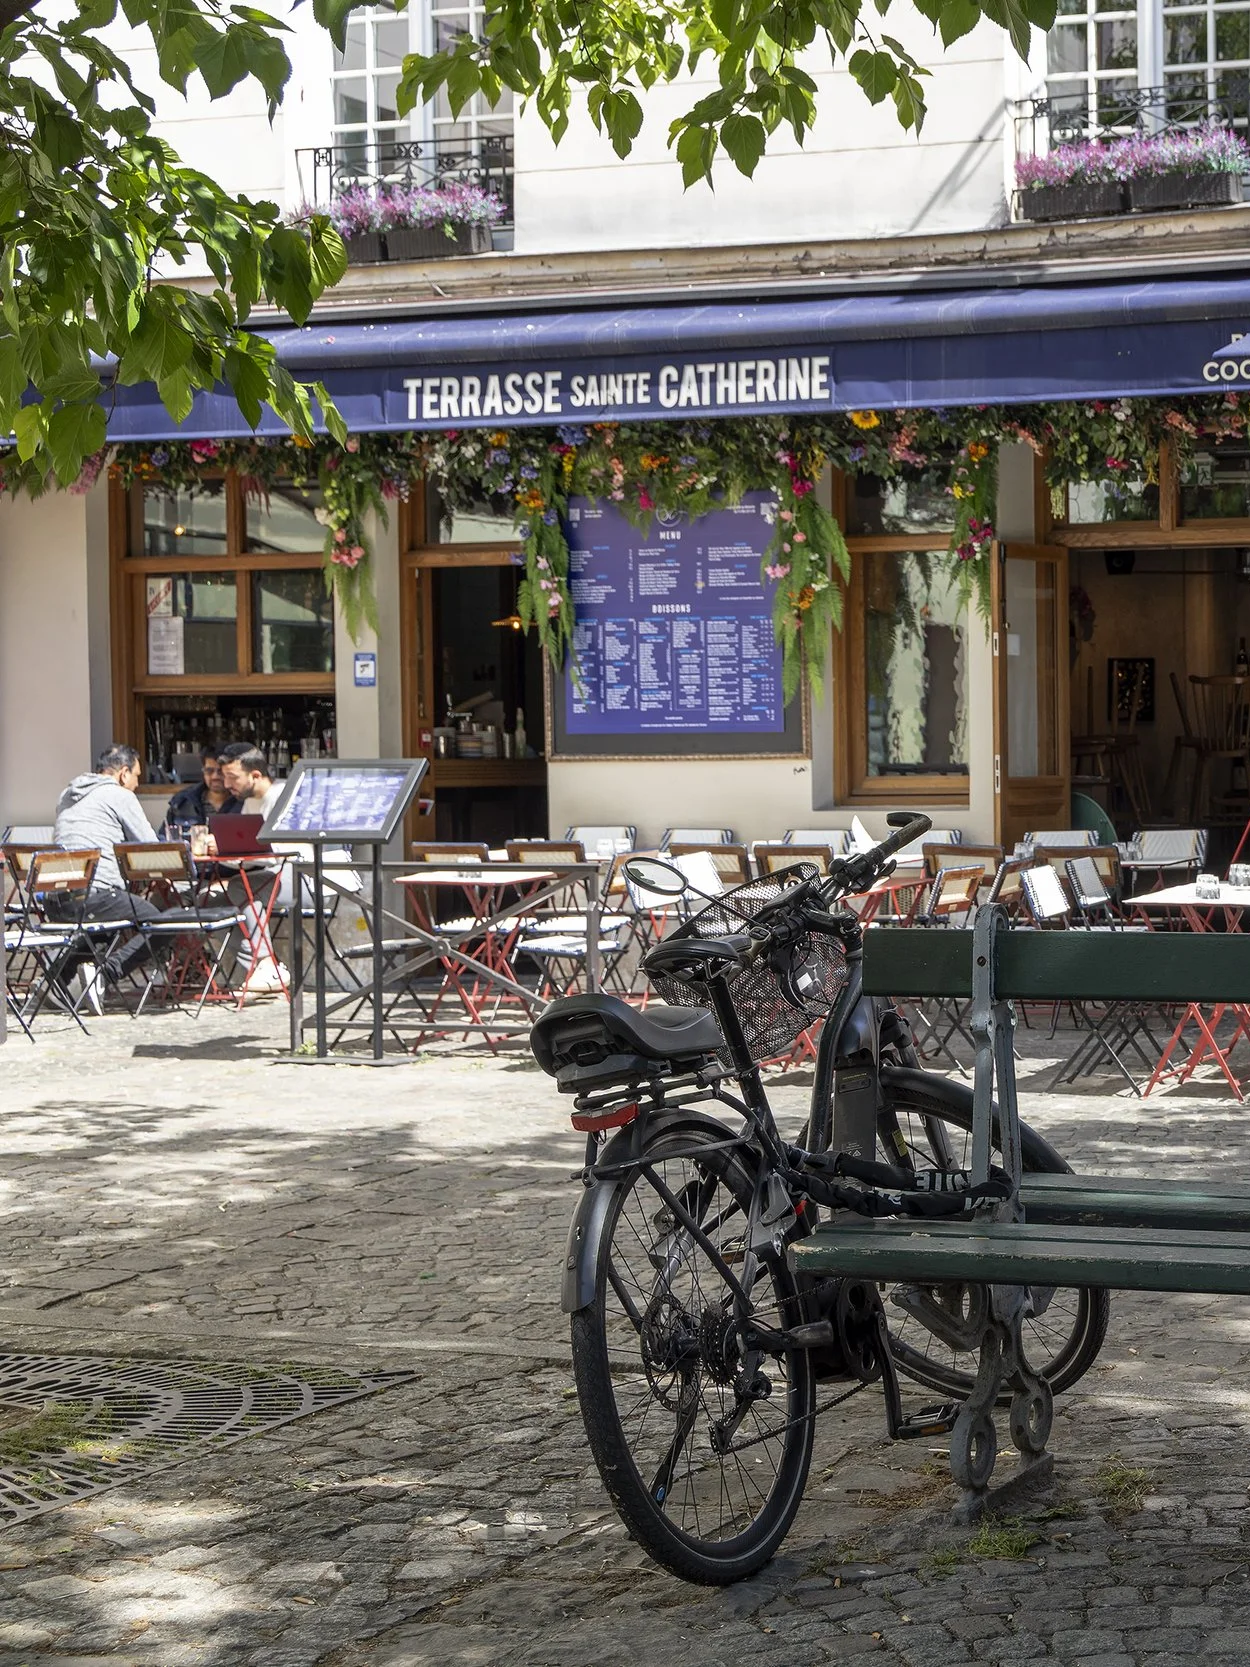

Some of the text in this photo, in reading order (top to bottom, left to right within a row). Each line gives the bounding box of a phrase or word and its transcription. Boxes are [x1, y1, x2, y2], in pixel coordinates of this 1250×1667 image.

[403, 356, 830, 420] TERRASSE SAINTE CATHERINE
[659, 531, 681, 540] MENU
[652, 604, 691, 614] BOISSONS
